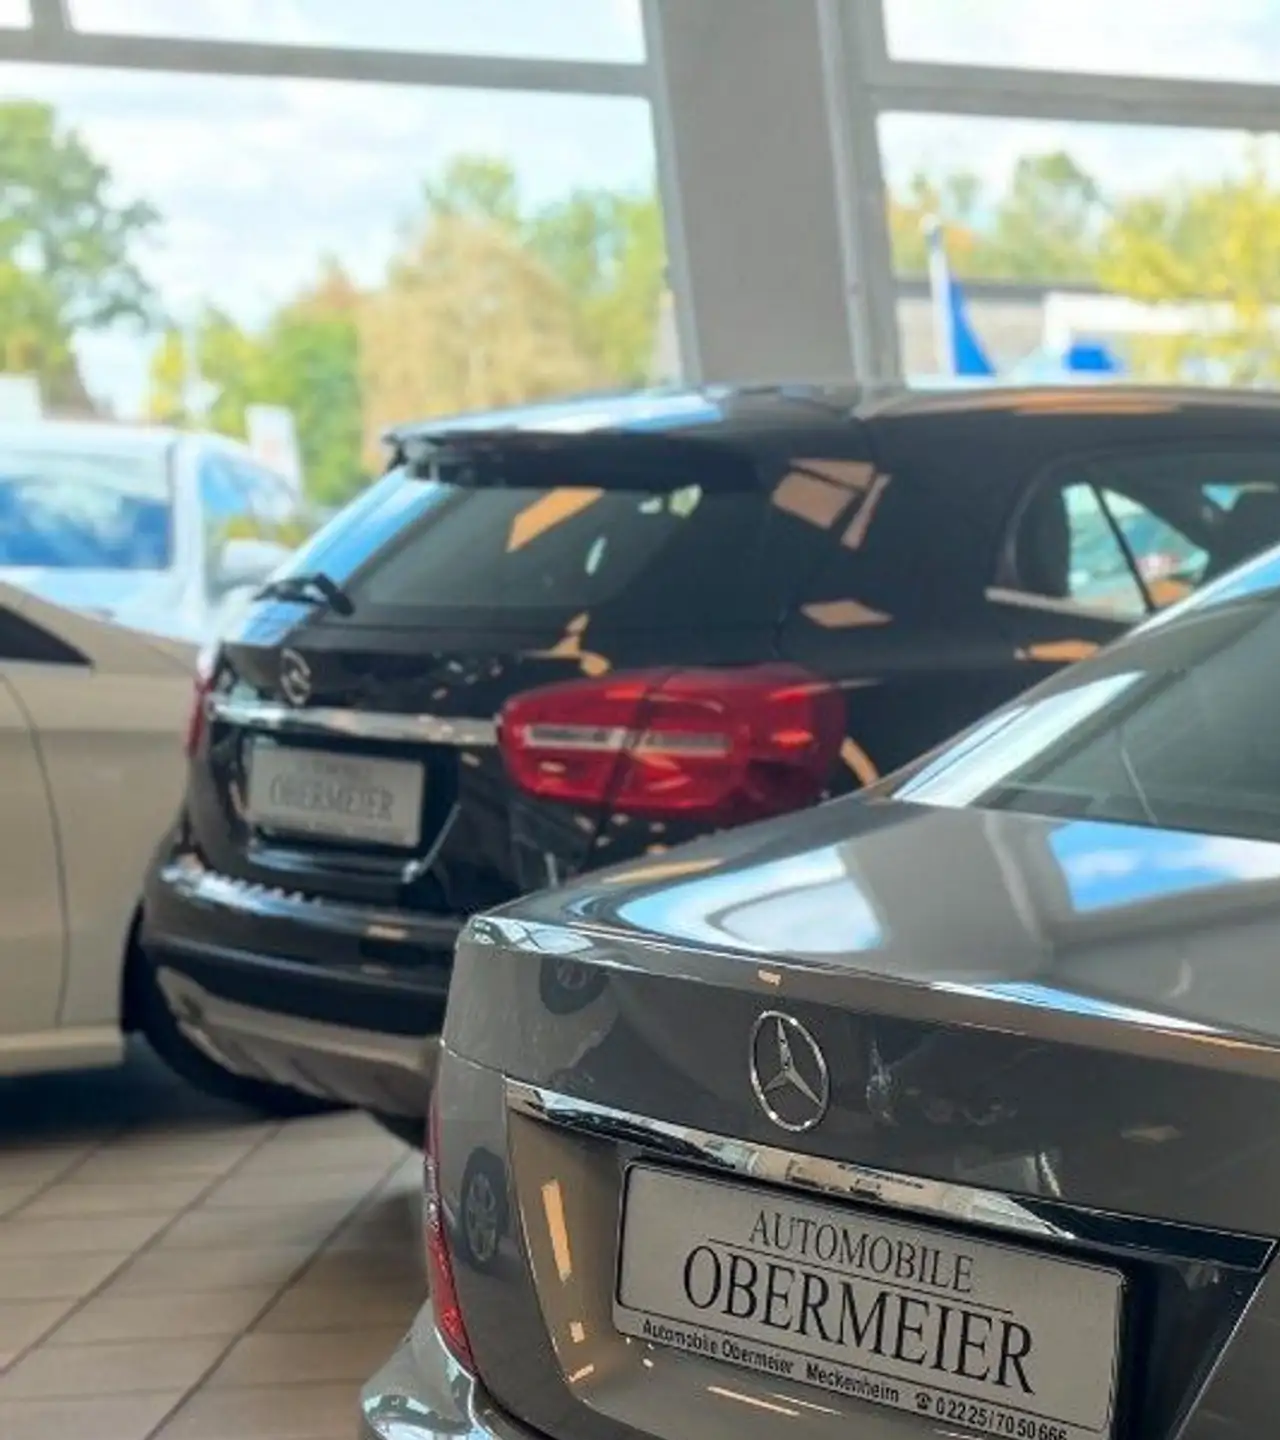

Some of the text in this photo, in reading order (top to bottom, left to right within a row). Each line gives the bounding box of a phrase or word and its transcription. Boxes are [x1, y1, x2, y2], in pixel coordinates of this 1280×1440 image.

[749, 1209, 975, 1294] AUTOMOBILE
[642, 1319, 719, 1355] Automobile
[722, 1339, 795, 1374] Obermeier
[806, 1362, 900, 1402] Meckenheim
[683, 1245, 1035, 1395] OBERMEIER
